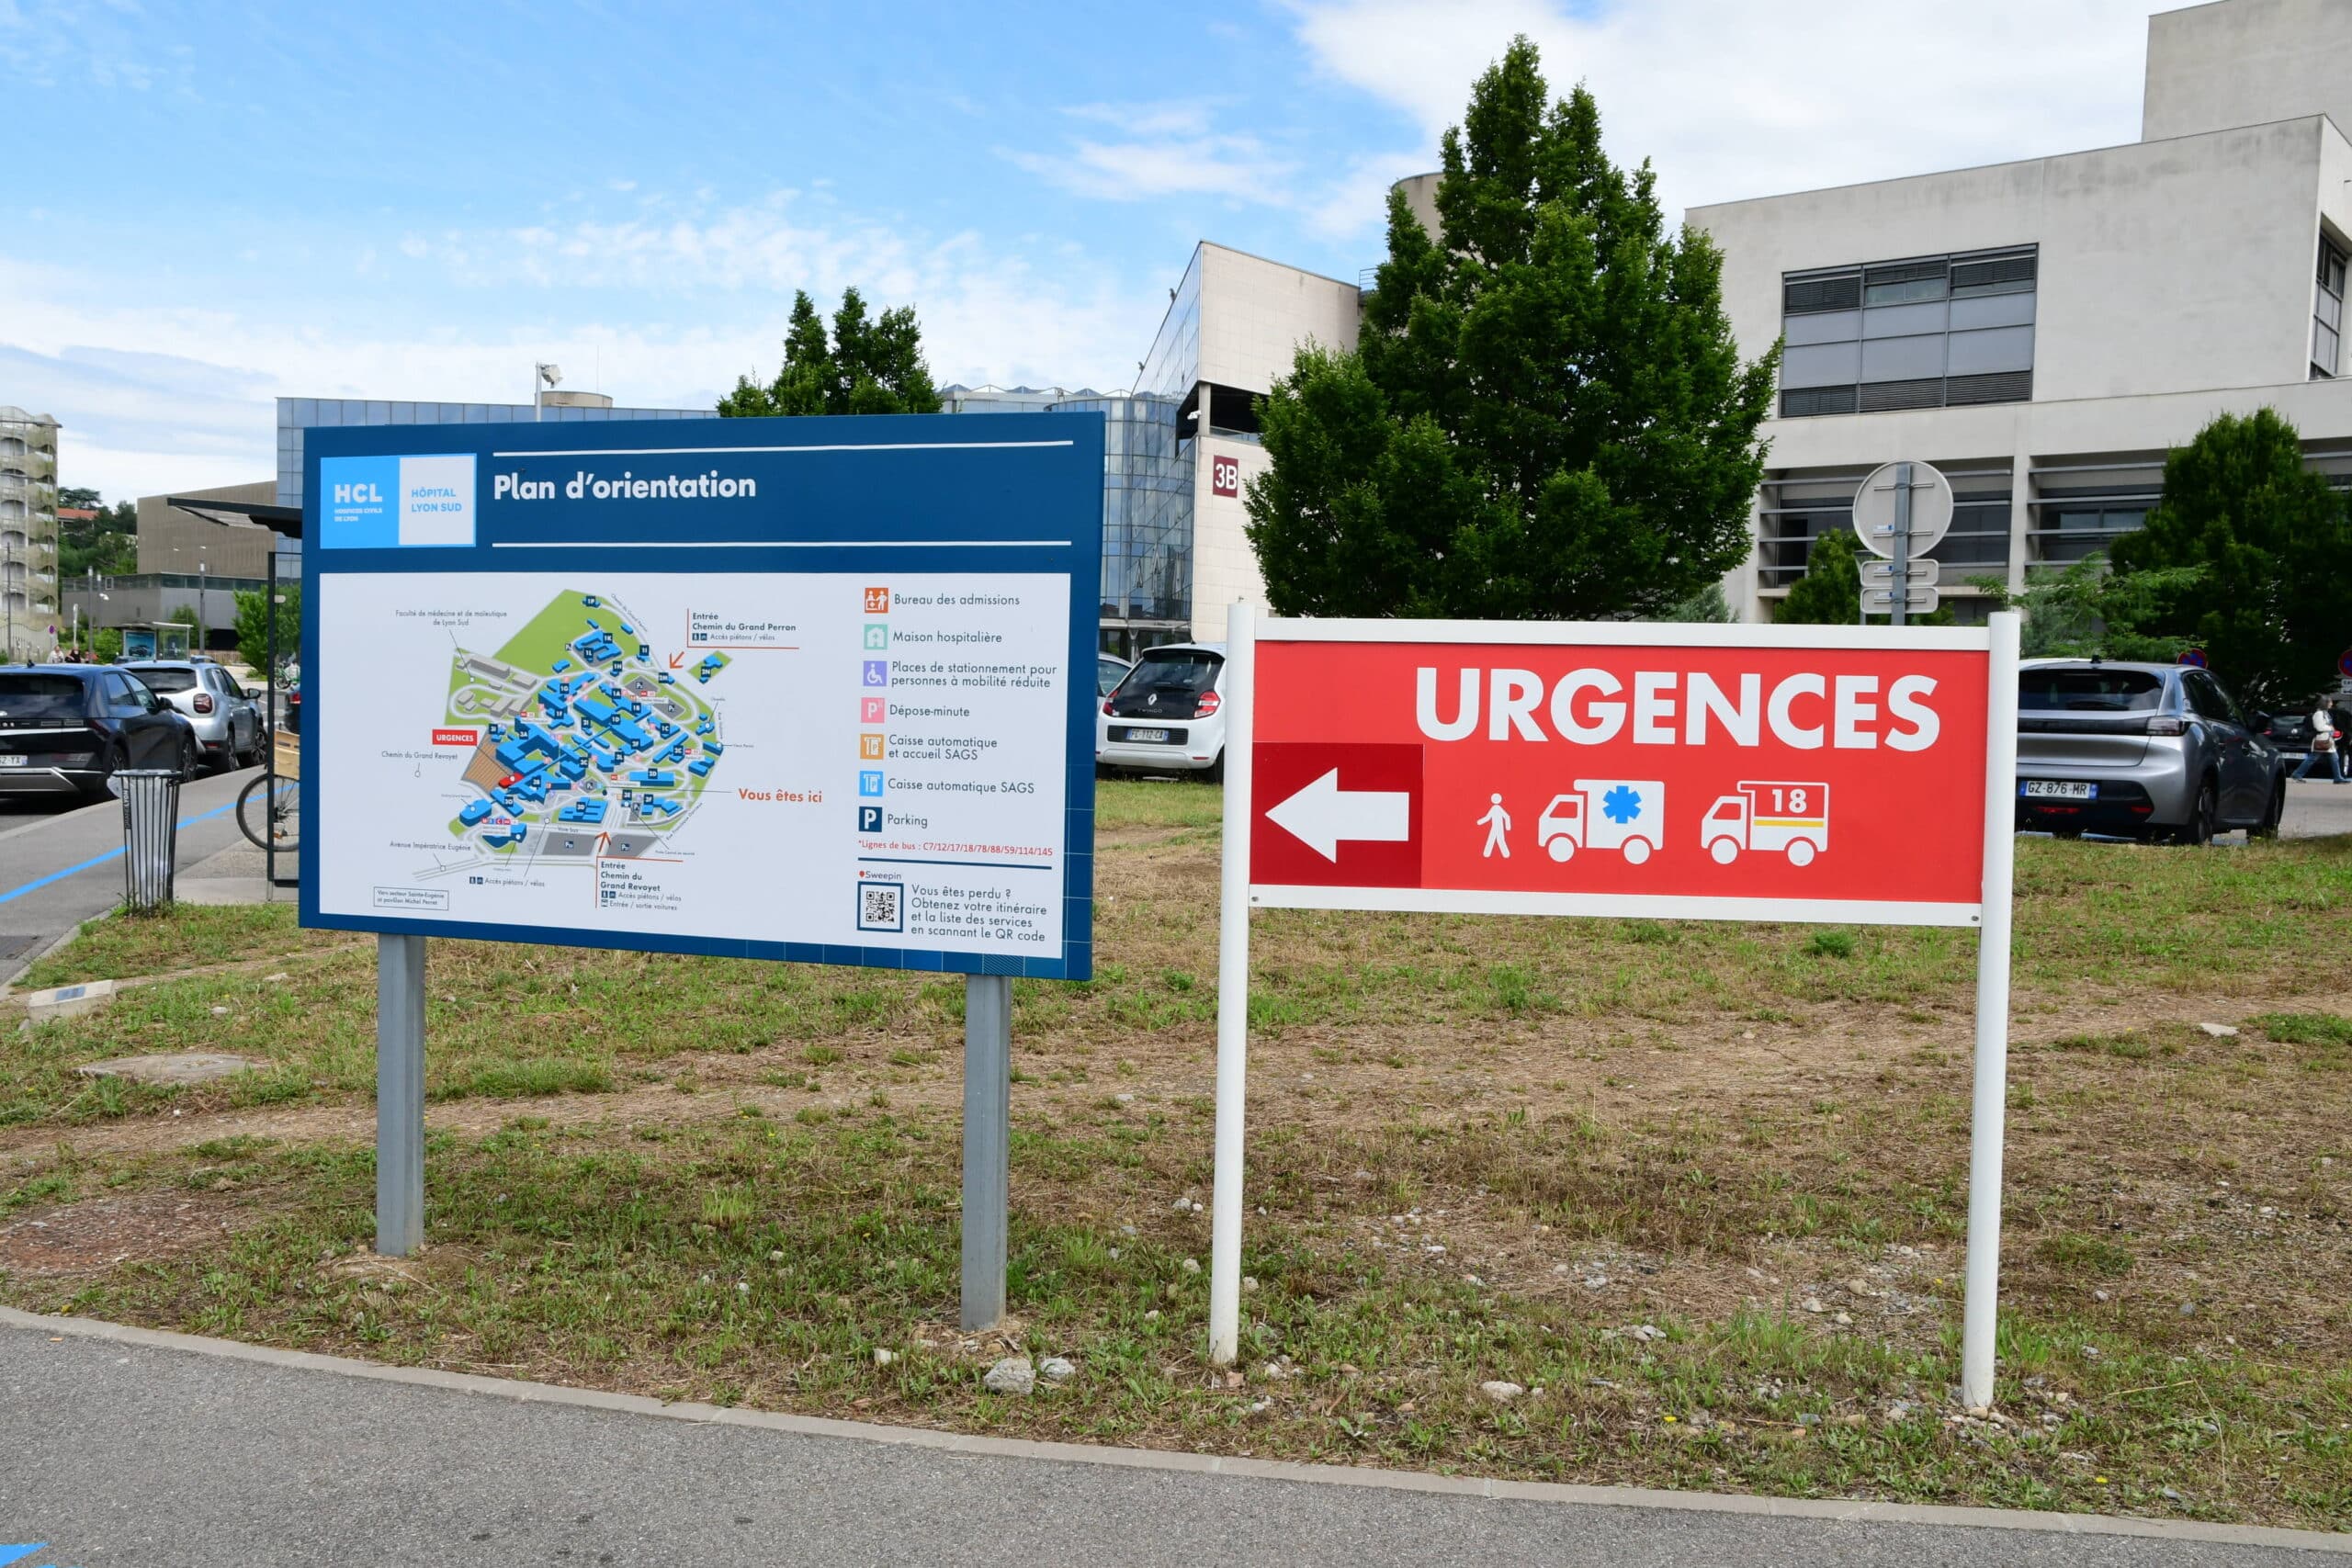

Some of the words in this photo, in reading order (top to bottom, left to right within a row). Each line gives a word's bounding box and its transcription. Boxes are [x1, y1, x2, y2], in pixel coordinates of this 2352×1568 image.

[1216, 464, 1237, 490] 3B
[494, 473, 555, 500] Plan
[566, 470, 755, 499] d'orientation
[334, 483, 382, 503] HCL
[412, 487, 456, 498] HÔPITAL
[412, 503, 438, 512] LYON
[441, 502, 461, 512] SUD
[895, 593, 933, 604] Bureau
[937, 593, 956, 604] des
[960, 593, 1020, 604] admissions
[893, 632, 933, 641] Maison
[937, 630, 1001, 645] hospitalière
[893, 660, 926, 672] Places
[931, 661, 944, 672] de
[948, 662, 1025, 673] stationnement
[1030, 667, 1057, 678] pour
[892, 678, 946, 687] personnes
[951, 675, 957, 685] à
[963, 675, 1006, 686] mobilité
[1012, 677, 1050, 687] réduite
[890, 705, 969, 718] Dépose-minute
[1415, 667, 1940, 753] URGENCES
[889, 735, 923, 745] Caisse
[928, 737, 997, 749] automatique
[381, 750, 402, 760] Chemin
[402, 750, 412, 758] du
[889, 750, 899, 758] et
[903, 748, 940, 759] accueil
[945, 749, 978, 760] SAGS
[888, 778, 922, 789] Caisse
[927, 782, 996, 795] automatique
[1001, 782, 1034, 794] SAGS
[739, 788, 771, 800] Vous
[776, 789, 803, 802] êtes
[808, 791, 821, 802] ici
[1772, 789, 1806, 813] 18
[888, 814, 927, 829] Parking
[448, 843, 470, 852] Eugénie
[601, 871, 629, 879] Chemin
[865, 871, 901, 882] Sweepin
[601, 882, 625, 891] Grand
[628, 883, 660, 893] Revoyet
[911, 885, 938, 896] Vous
[943, 886, 964, 897] êtes
[969, 887, 1001, 900] perdu
[1006, 889, 1011, 898] ?
[911, 897, 961, 911] Obtenez
[964, 901, 992, 911] votre
[997, 902, 1046, 917] itinéraire
[911, 912, 921, 920] et
[926, 910, 935, 921] la
[940, 911, 961, 923] liste
[966, 913, 984, 924] des
[989, 916, 1032, 927] services
[929, 928, 977, 937] scannant
[981, 927, 990, 938] le
[996, 929, 1012, 939] QR
[1018, 931, 1045, 942] code
